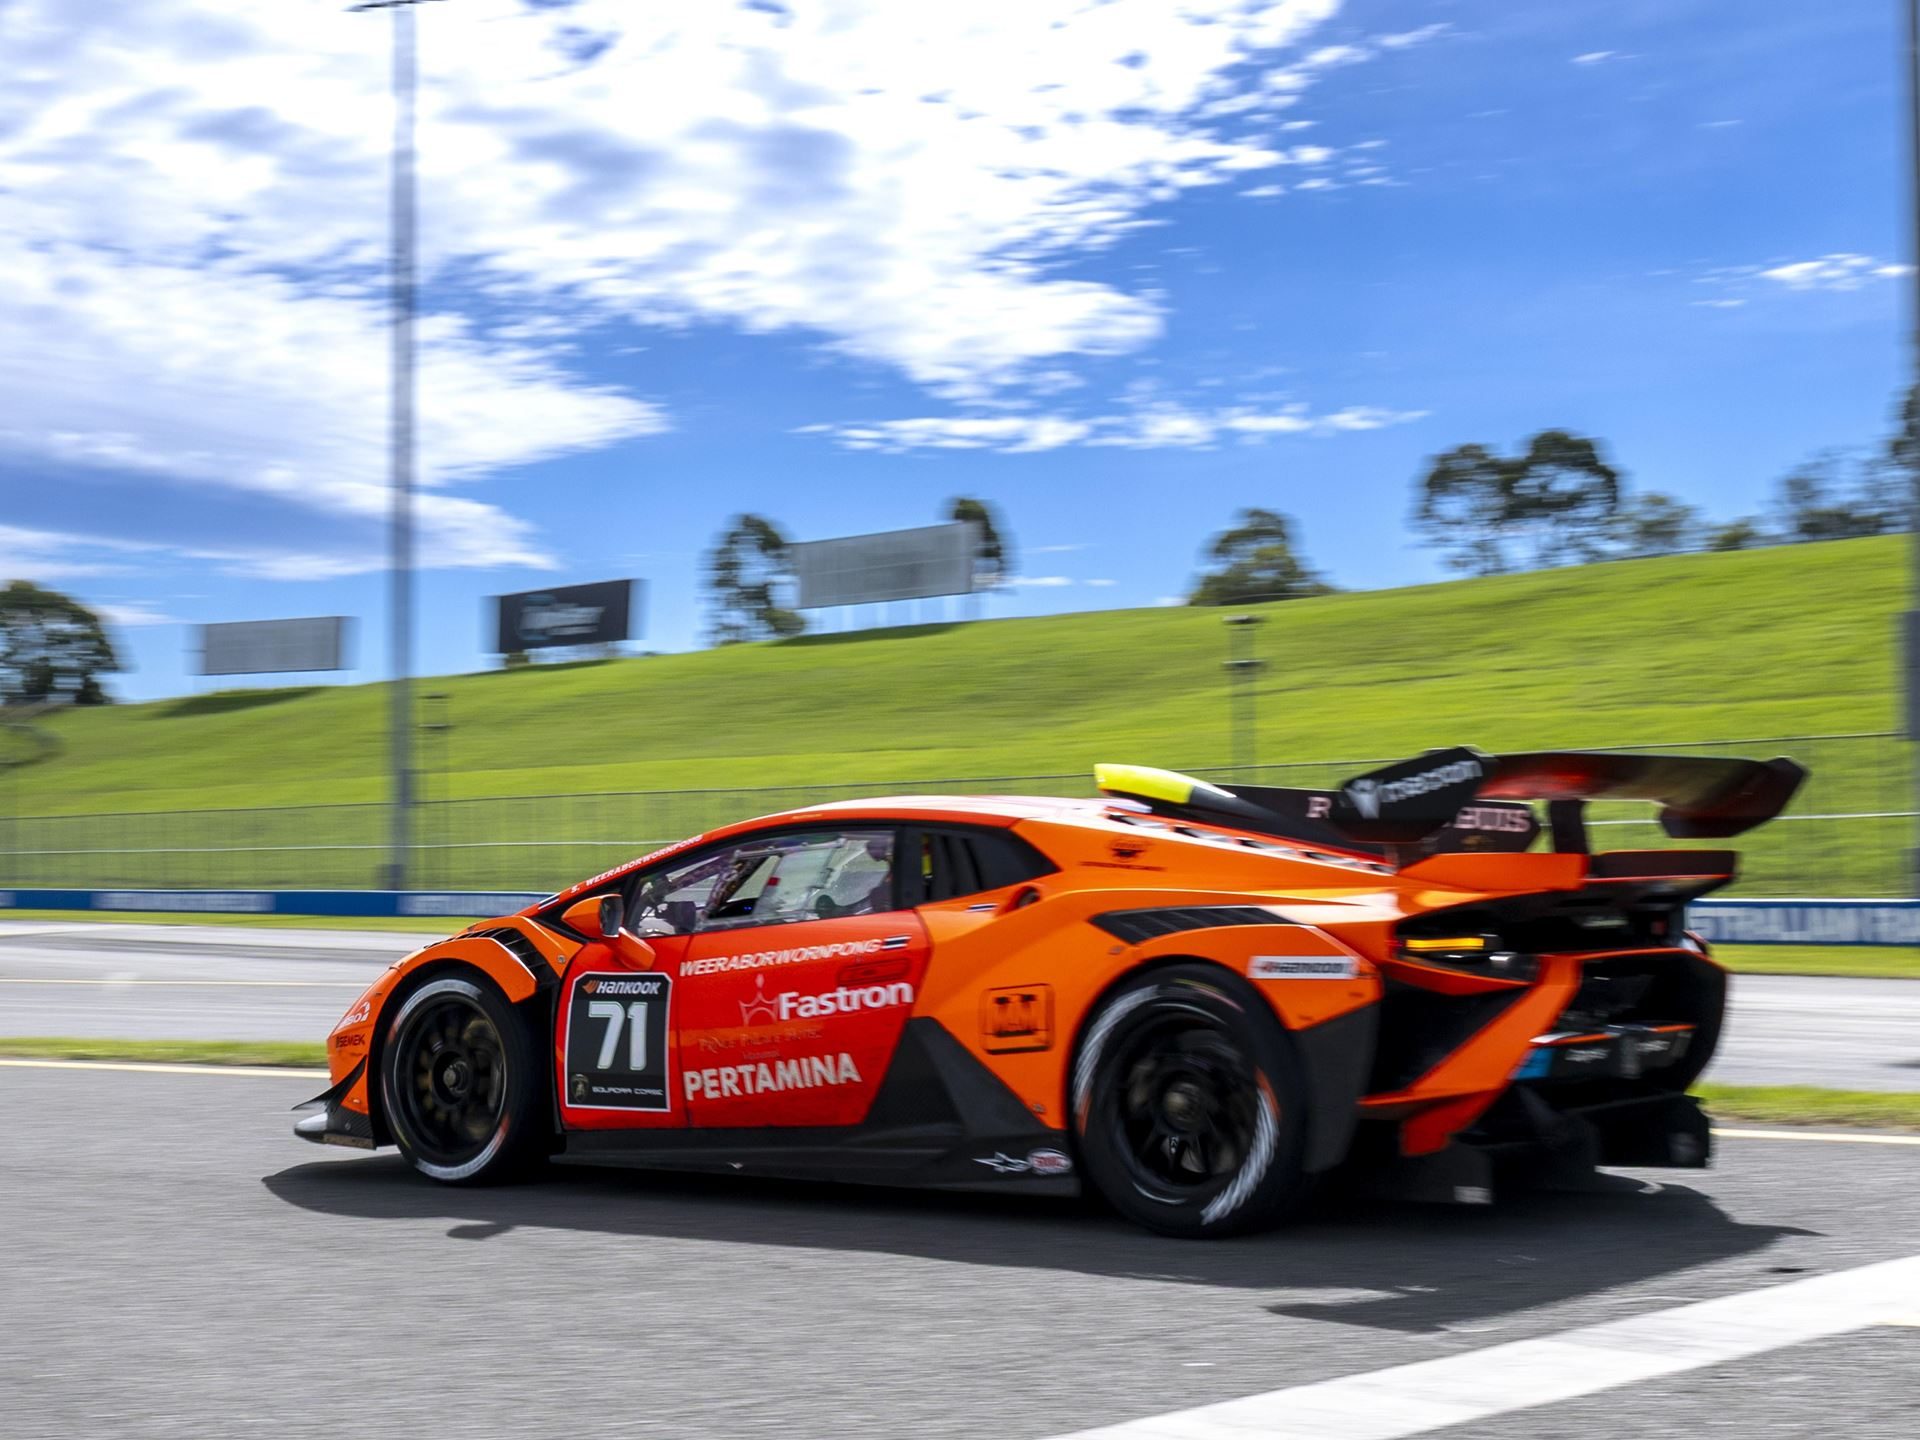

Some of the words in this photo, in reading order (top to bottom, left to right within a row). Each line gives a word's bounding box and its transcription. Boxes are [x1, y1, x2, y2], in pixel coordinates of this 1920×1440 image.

[679, 939, 883, 977] WEERABORWORNPONG
[779, 982, 914, 1021] Fastron
[588, 1001, 648, 1071] 71
[683, 1053, 863, 1101] PERTAMINA
